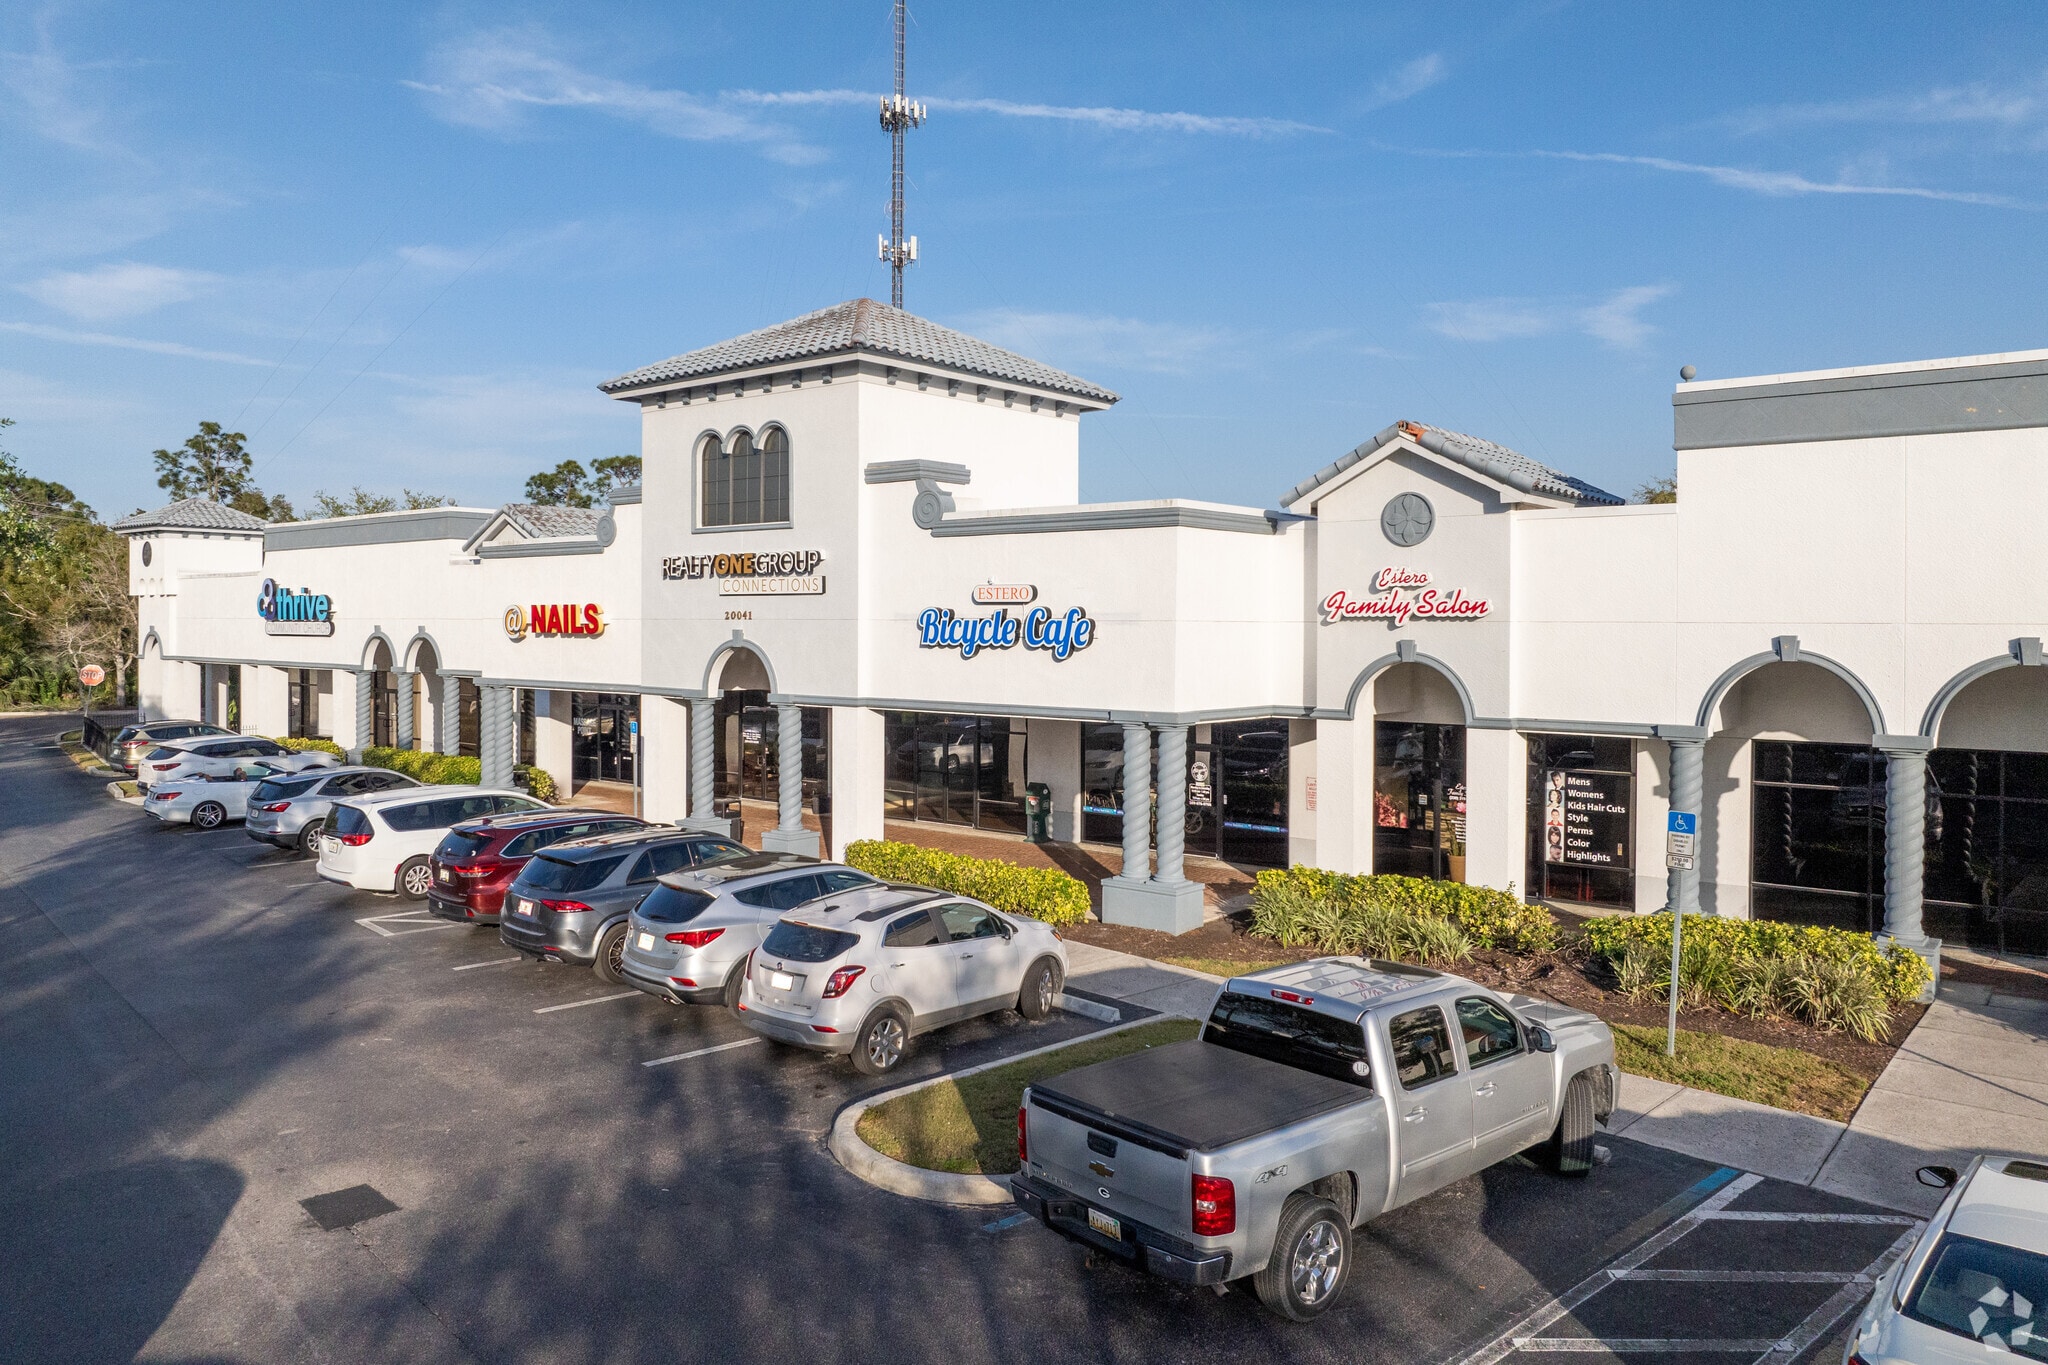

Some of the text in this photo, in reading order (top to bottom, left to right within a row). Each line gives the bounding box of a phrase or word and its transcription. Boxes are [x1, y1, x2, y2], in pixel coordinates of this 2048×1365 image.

[1378, 567, 1428, 587] Estero
[722, 577, 819, 593] CONNECTIONS
[977, 586, 1029, 601] ESTERO
[275, 586, 329, 621] thrive
[1326, 588, 1488, 624] Family Salon
[531, 603, 601, 635] NAILS
[724, 610, 753, 621] 20041
[918, 606, 1091, 659] Bicycle Cafe
[82, 670, 103, 680] STOP
[1567, 777, 1591, 786] Mens
[1567, 789, 1604, 800] Womens
[1567, 802, 1626, 814] Kids Hair Cuts
[1567, 814, 1589, 823] Style
[1567, 826, 1594, 835] Perms
[1567, 838, 1591, 848] Color
[1567, 850, 1611, 863] Highlights
[1356, 1063, 1368, 1073] UP
[1098, 1187, 1110, 1199] G
